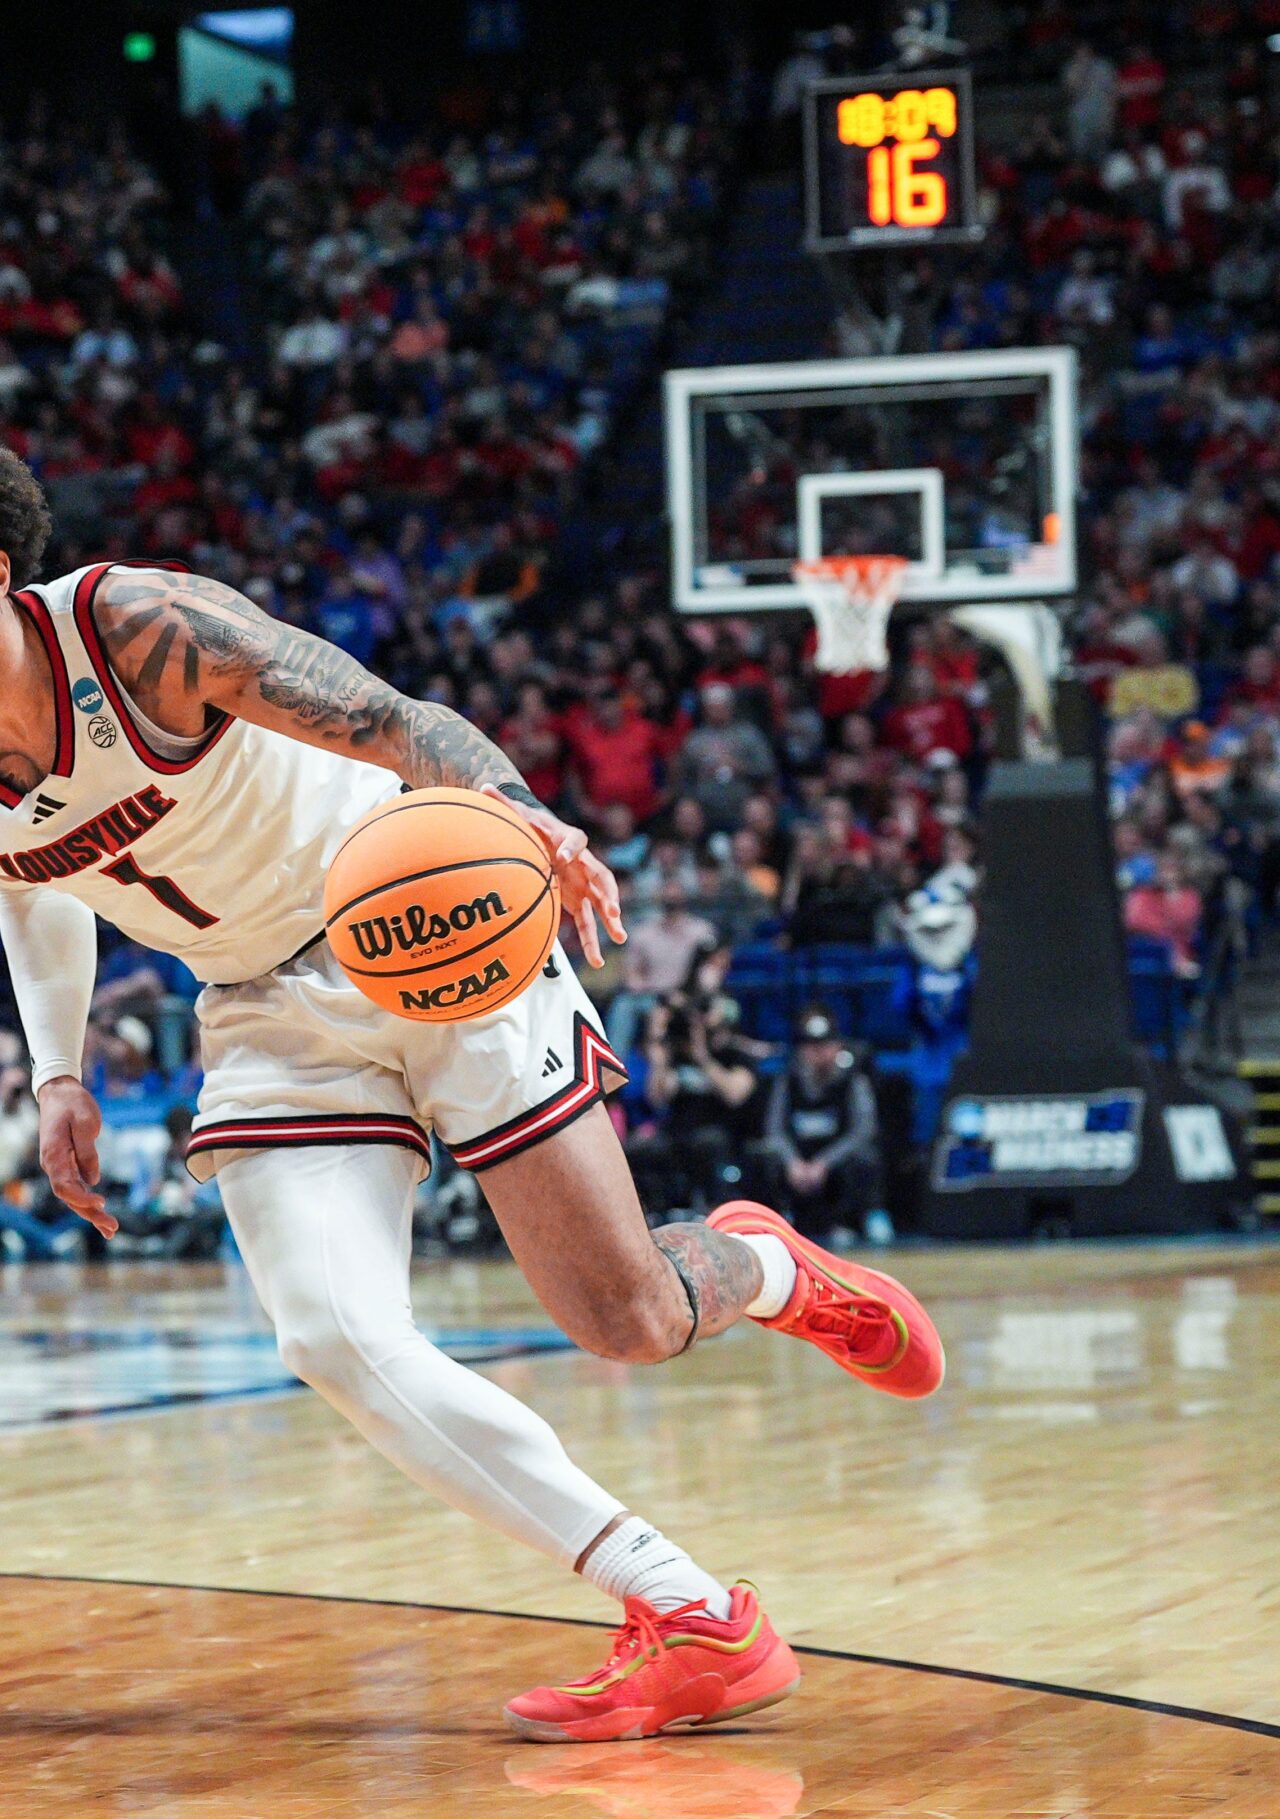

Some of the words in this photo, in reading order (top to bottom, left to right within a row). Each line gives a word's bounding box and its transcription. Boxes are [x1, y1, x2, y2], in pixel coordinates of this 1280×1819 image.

[867, 138, 947, 227] 16
[78, 691, 102, 708] NCAA
[93, 722, 113, 738] ACC
[98, 851, 221, 930] 1
[349, 891, 508, 960] Wilson
[410, 948, 433, 959] EVO
[435, 938, 458, 951] NXT
[398, 958, 511, 1010] NCAA
